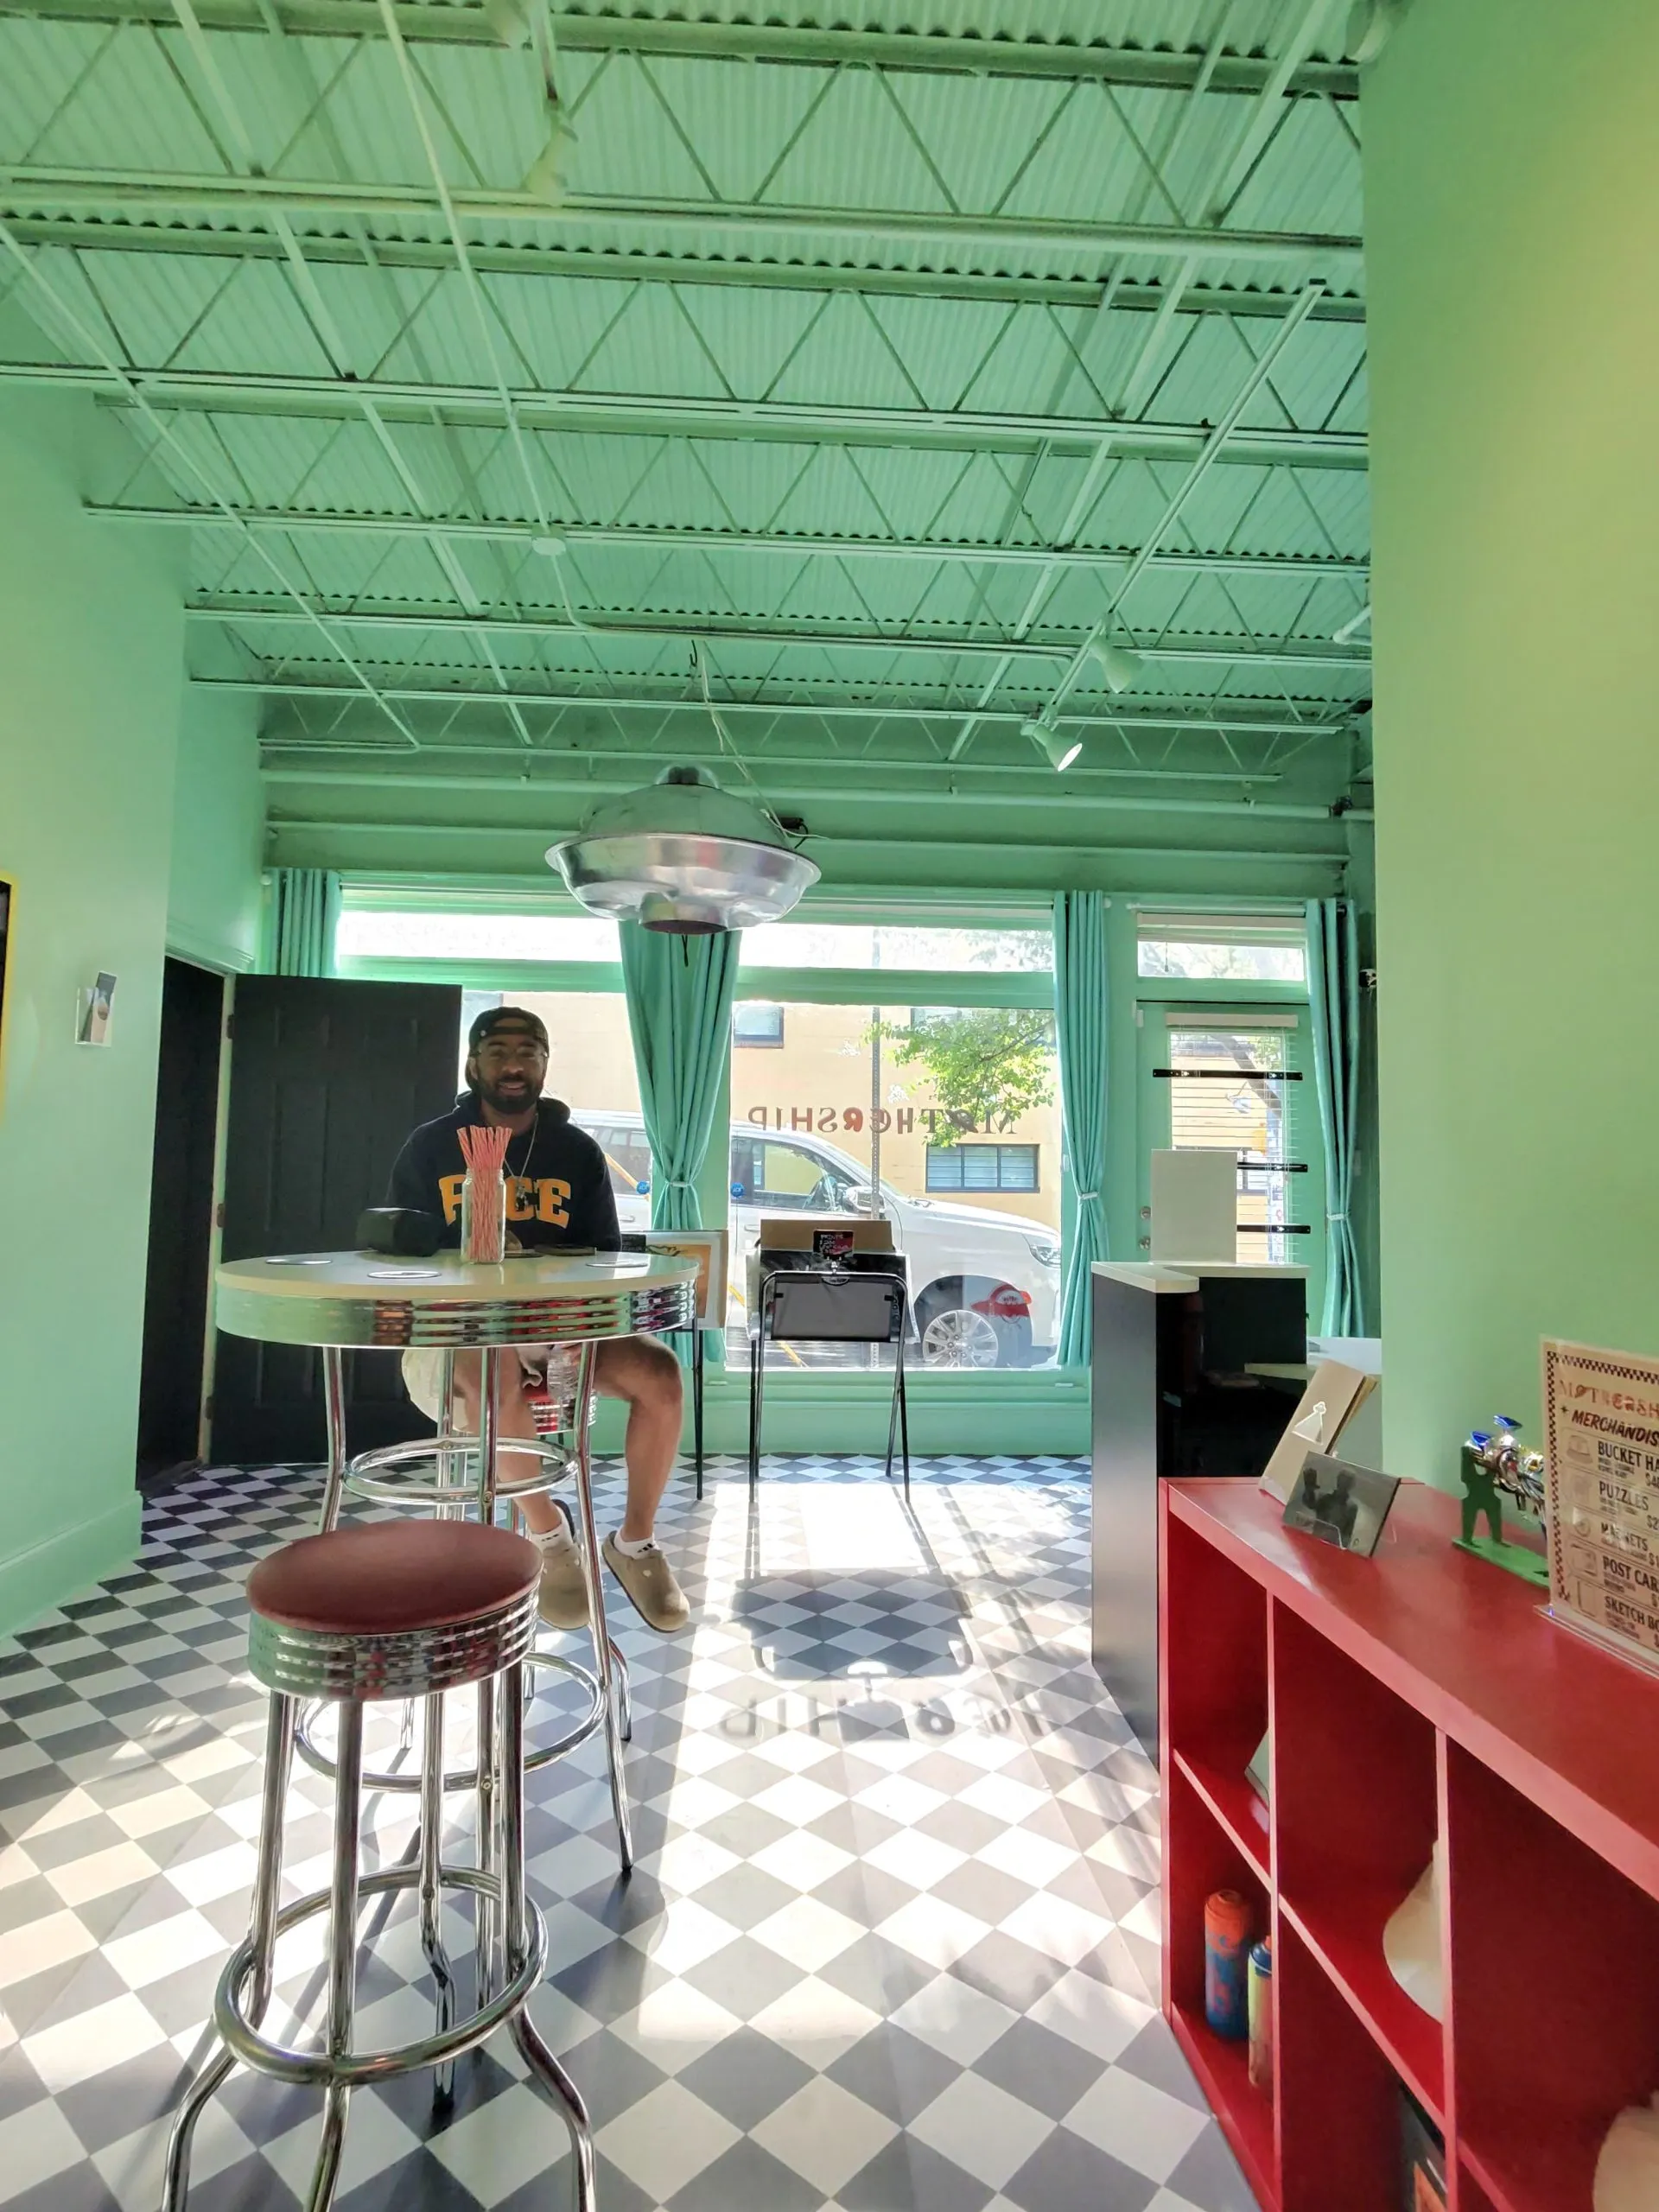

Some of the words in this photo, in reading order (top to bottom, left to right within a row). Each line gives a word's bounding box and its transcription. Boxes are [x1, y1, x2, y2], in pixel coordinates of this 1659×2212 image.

[1598, 1440, 1642, 1468] BUCKET
[1599, 1480, 1649, 1511] PUZZLES
[1603, 1555, 1631, 1580] POST
[1605, 1595, 1645, 1625] SKETCH
